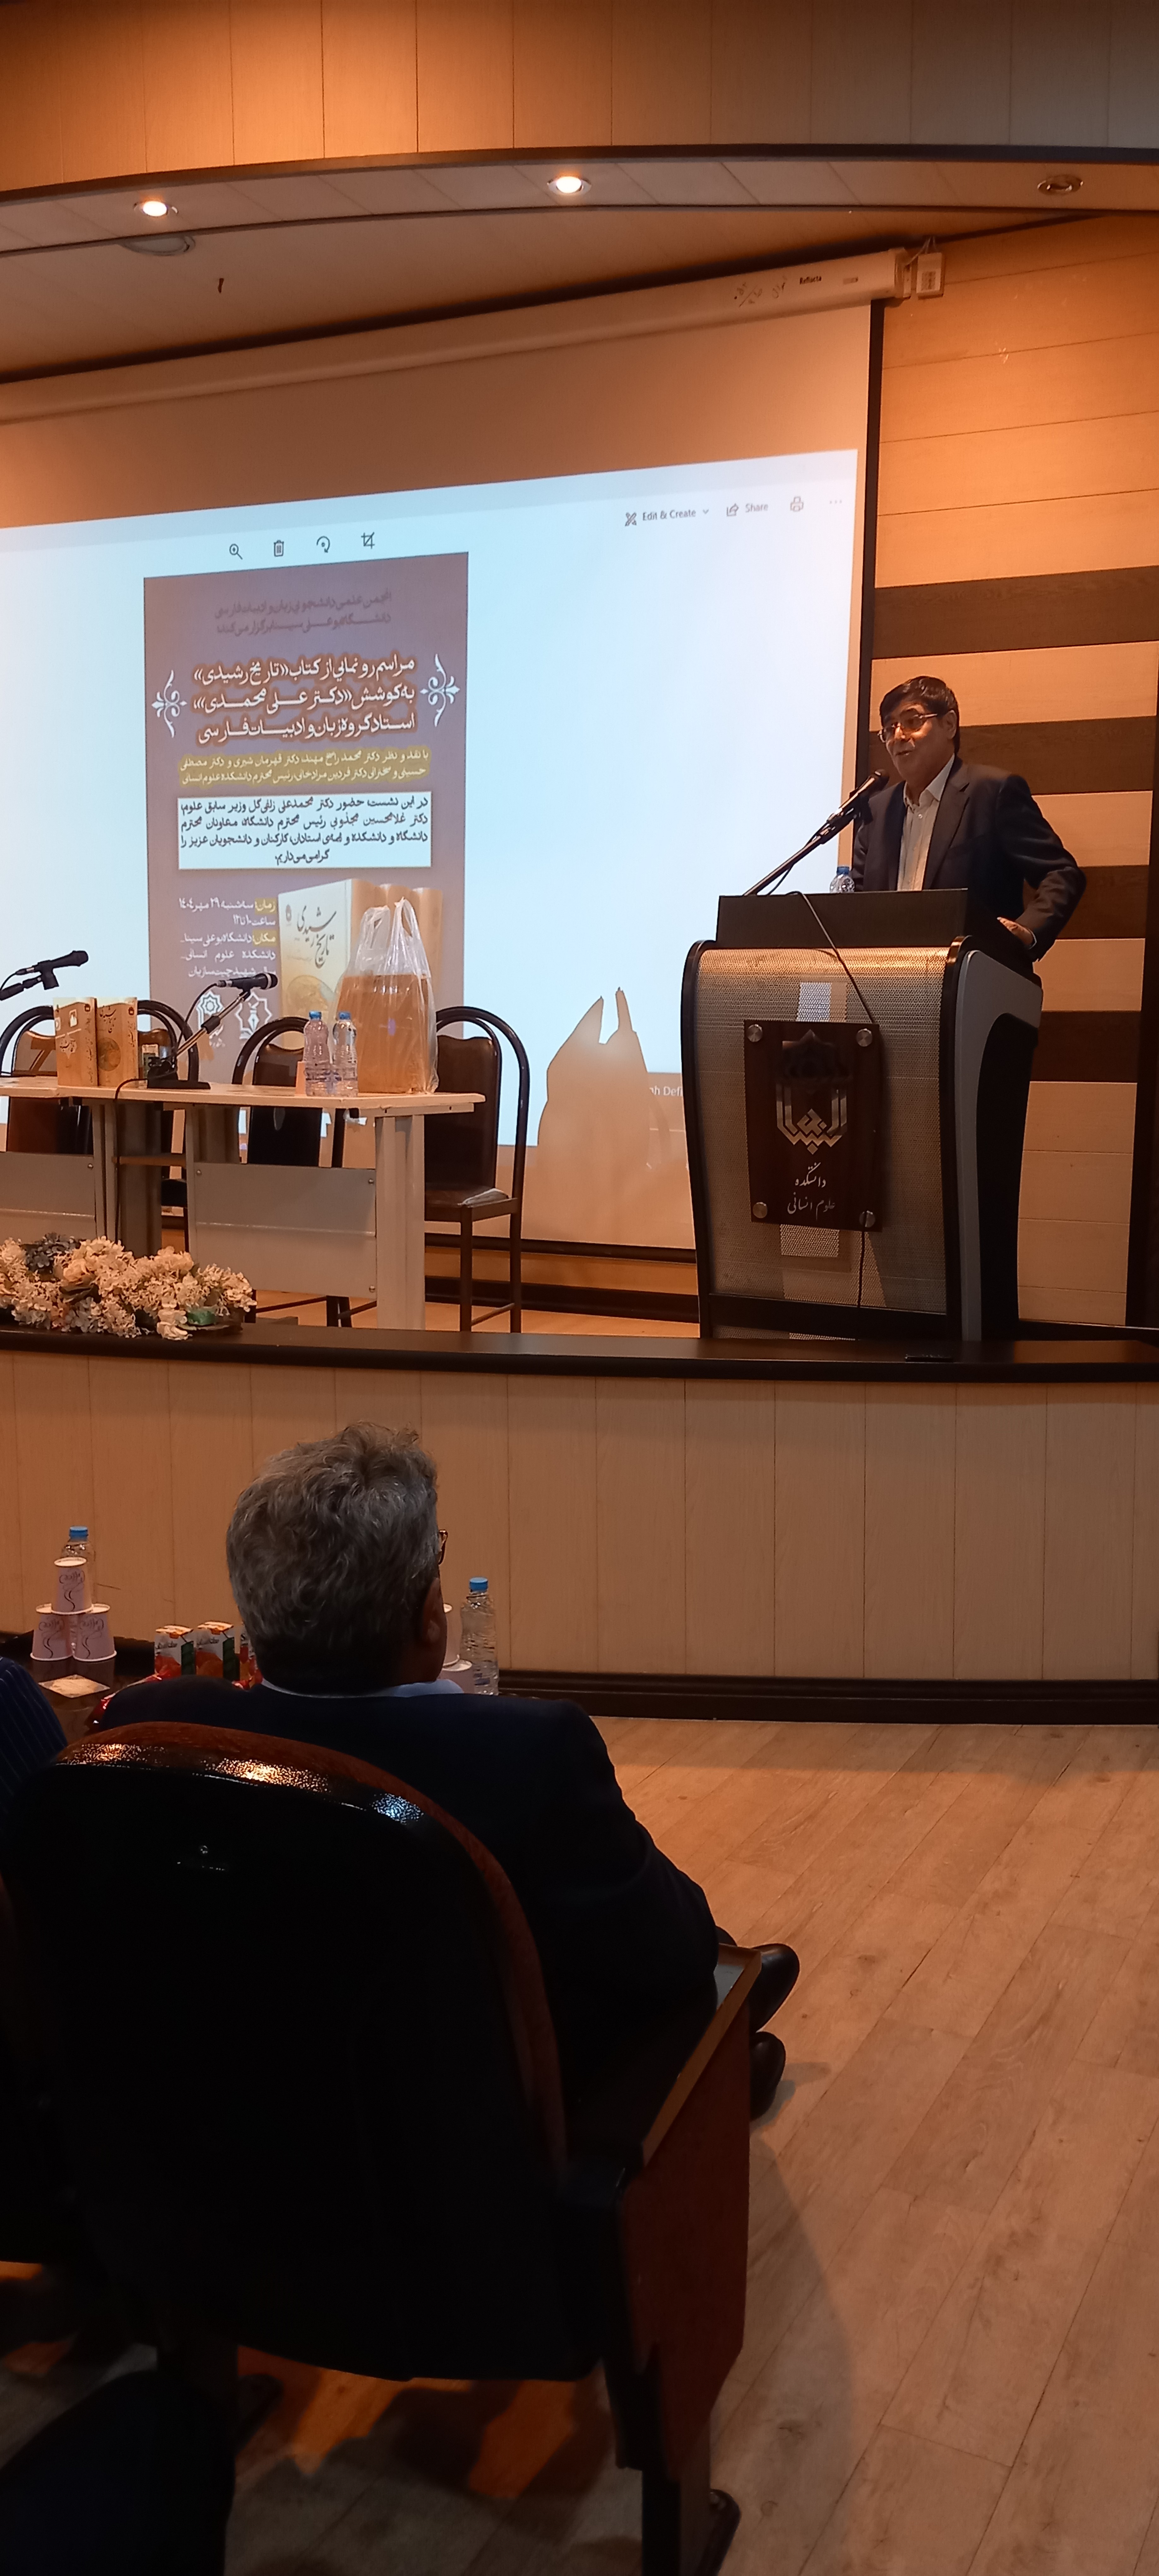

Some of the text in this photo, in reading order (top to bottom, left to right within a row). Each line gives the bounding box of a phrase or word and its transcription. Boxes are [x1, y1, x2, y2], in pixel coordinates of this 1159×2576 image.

[745, 503, 768, 512] Share
[643, 509, 696, 521] Edit & Create
[250, 661, 289, 685] «تاریخ
[289, 658, 321, 681] کتاب
[319, 658, 332, 680] از
[376, 654, 414, 681] مراسم
[194, 665, 249, 685] رشیدی»
[307, 686, 352, 710] «دکتر
[351, 683, 402, 710] کوشش
[398, 685, 415, 704] به
[267, 691, 308, 714] علی
[248, 717, 305, 738] ادبیات
[314, 716, 342, 737] زبان
[371, 712, 415, 732] استاد
[199, 717, 249, 744] فارسی
[305, 724, 316, 739] و
[254, 753, 282, 767] قهرمان
[284, 754, 300, 767] دکتر
[341, 750, 362, 761] محمد
[363, 751, 380, 764] دکتر
[381, 751, 398, 764] نظر
[399, 754, 405, 763] و
[406, 750, 421, 760] نقد
[423, 749, 429, 761] با
[180, 758, 208, 771] مصطفی
[209, 756, 224, 769] دکتر
[227, 760, 232, 769] و
[233, 757, 253, 768] شیری
[182, 772, 202, 784] انسانی
[202, 773, 220, 785] علوم
[221, 772, 252, 782] دانشکده
[252, 769, 272, 784] محترم
[273, 771, 294, 784] رئیس
[327, 766, 351, 782] فردین
[351, 767, 367, 781] دکتر
[367, 766, 391, 780] سخنرانی
[392, 770, 397, 779] و
[398, 767, 426, 780] حسینی
[205, 801, 226, 814] سابق
[227, 802, 247, 814] وزیر
[278, 796, 313, 814] محمدعلی
[316, 797, 334, 812] دکتر
[336, 797, 365, 811] حضور
[401, 795, 415, 810] این
[416, 797, 428, 809] در
[181, 816, 202, 833] محترم
[206, 817, 238, 831] معاونان
[277, 814, 300, 831] محترم
[304, 815, 326, 830] رئیس
[330, 812, 359, 830] مجذوبی
[363, 812, 406, 826] غلامحسین
[410, 813, 428, 827] دکتر
[181, 834, 187, 848] را
[188, 835, 208, 848] عزیز
[210, 833, 252, 847] دانشجویان
[253, 837, 259, 847] و
[261, 832, 289, 847] کارکنان
[344, 836, 350, 846] و
[352, 831, 387, 843] دانشکده
[388, 835, 395, 845] و
[396, 830, 428, 842] دانشگاه
[305, 848, 330, 864] گرامی
[192, 903, 209, 913] مهر
[223, 932, 253, 944] دانشگاه
[215, 950, 235, 963] علوم
[242, 950, 276, 961] دانشکده
[795, 1162, 826, 1188] دانشکده
[787, 1191, 835, 1221] علوم انسانی
